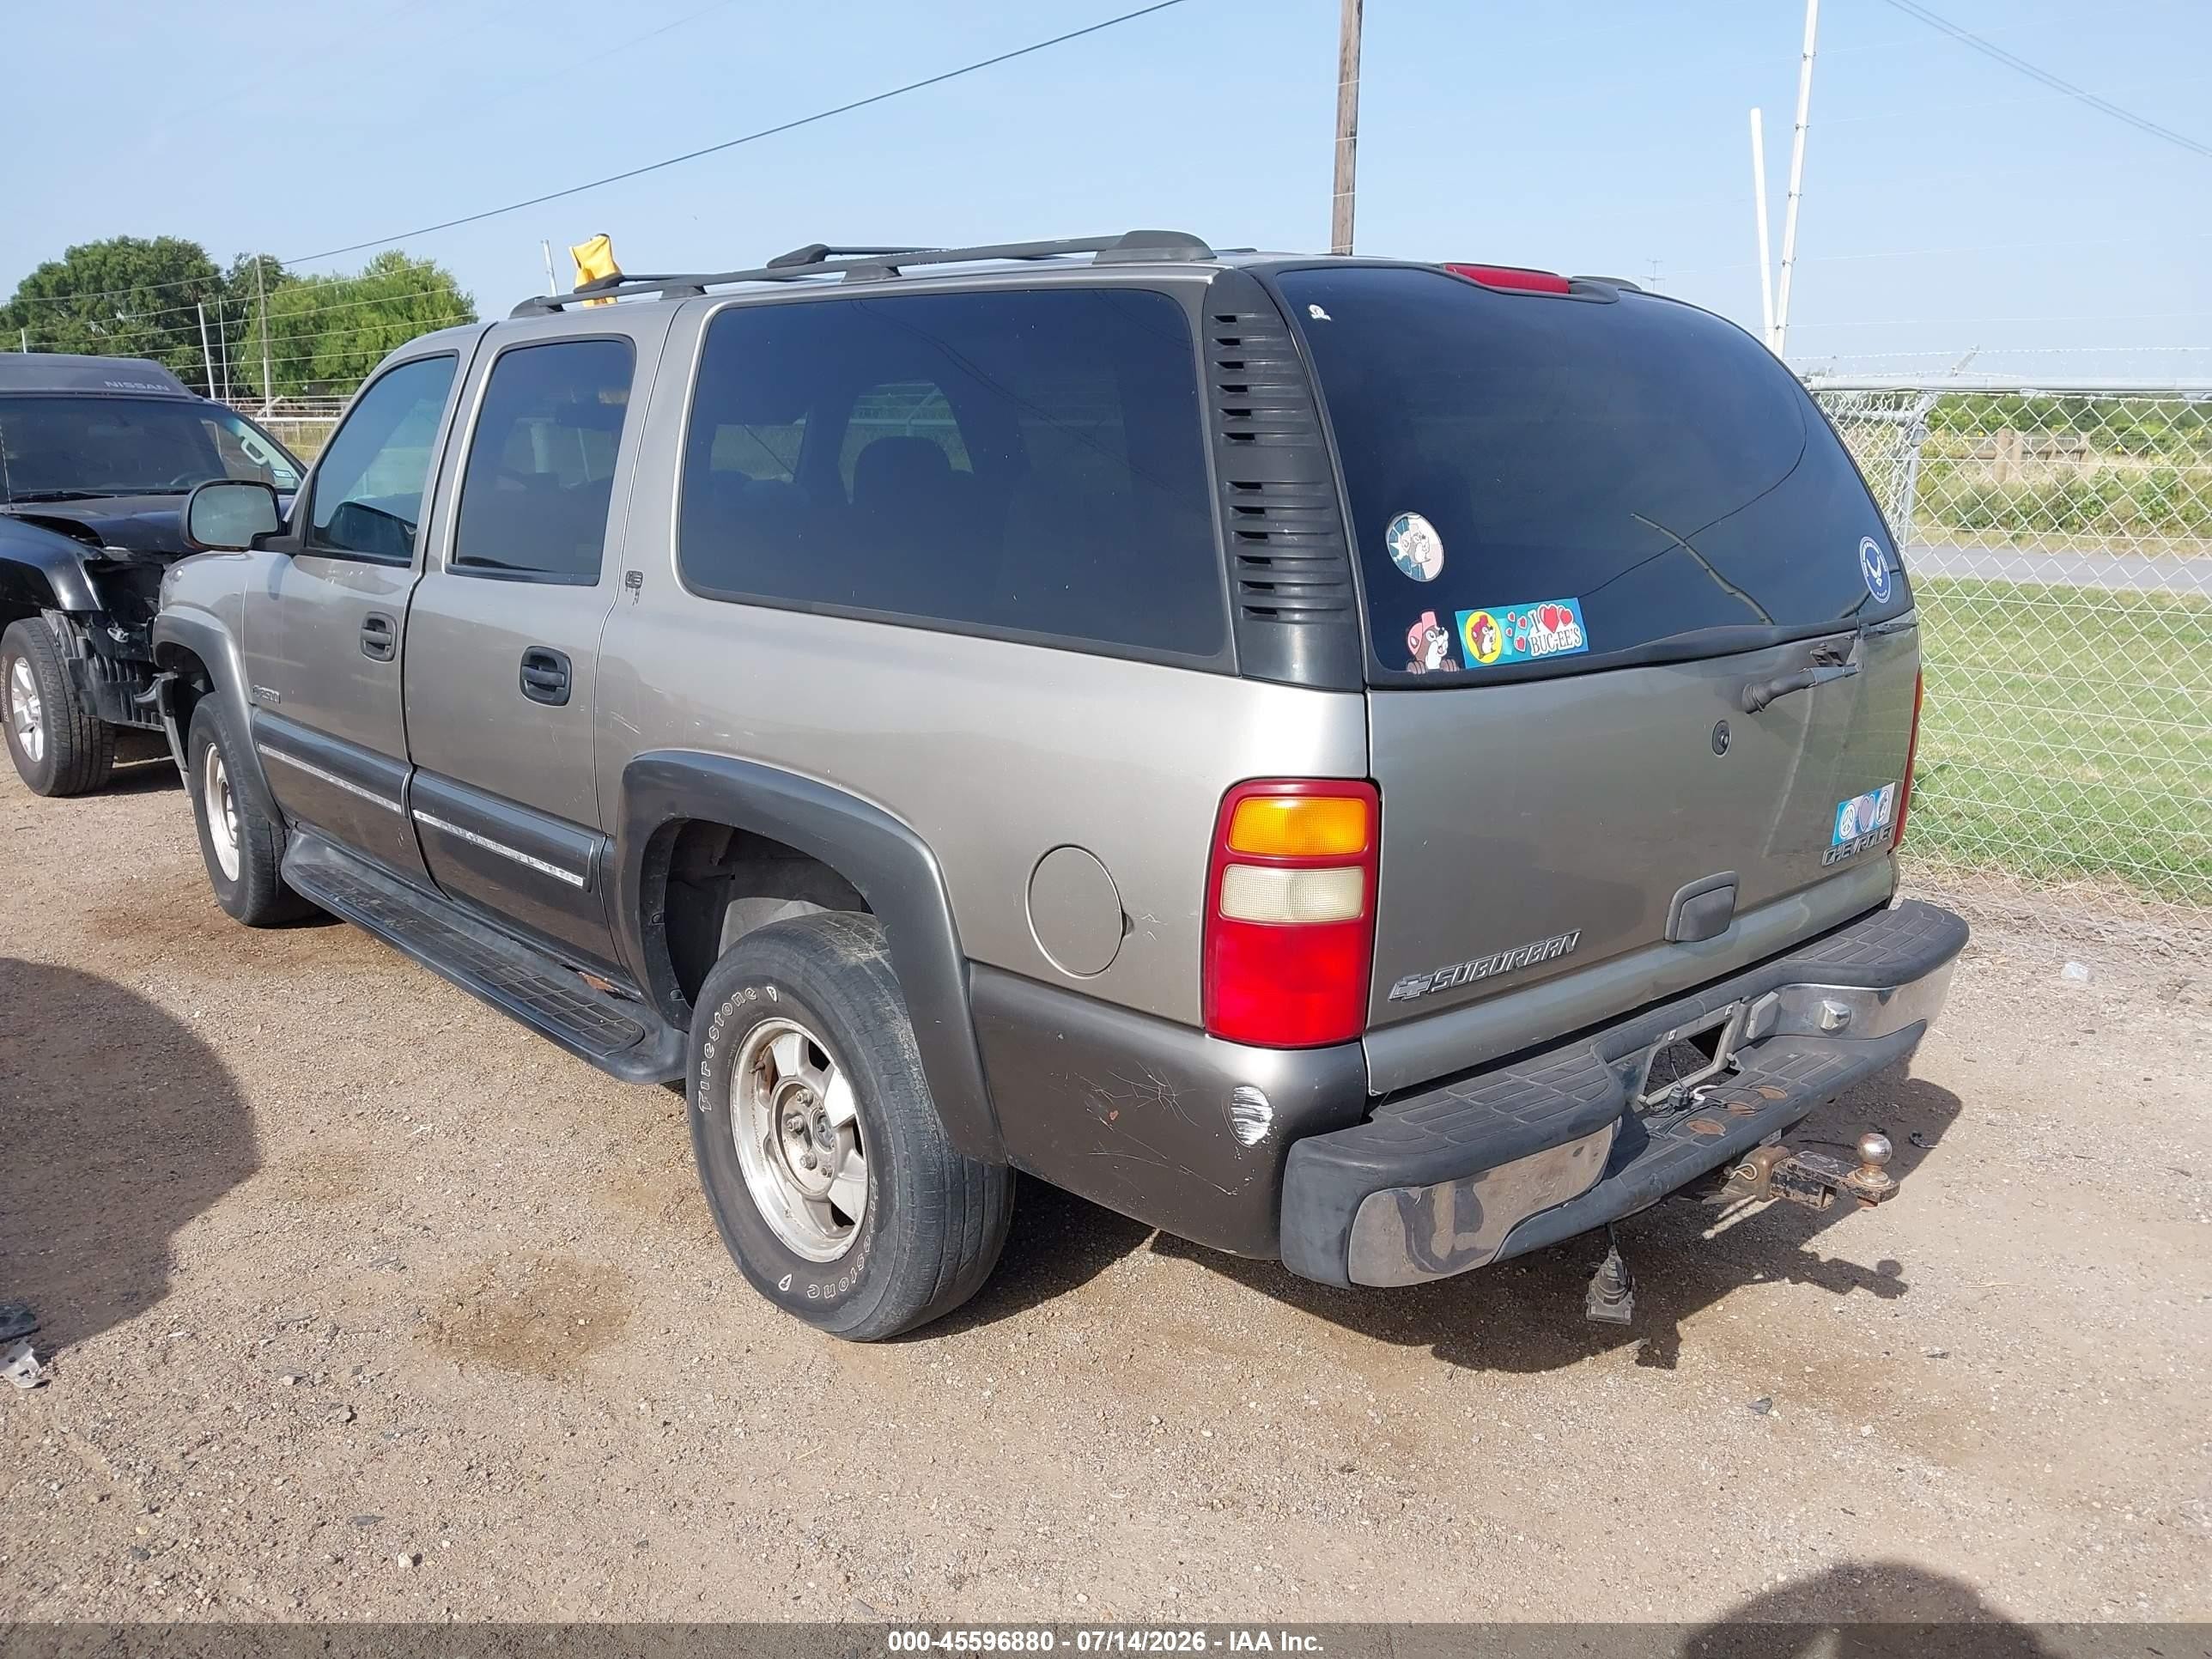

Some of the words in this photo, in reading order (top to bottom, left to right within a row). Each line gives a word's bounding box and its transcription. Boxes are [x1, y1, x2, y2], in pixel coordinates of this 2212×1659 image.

[103, 380, 171, 392] NISSAN
[1529, 611, 1540, 634] I
[1530, 627, 1582, 654] BUC-EE'S
[1821, 821, 1896, 867] CHEVROLET
[1430, 928, 1582, 993] SUBURBAN
[697, 987, 757, 1113] Firestone
